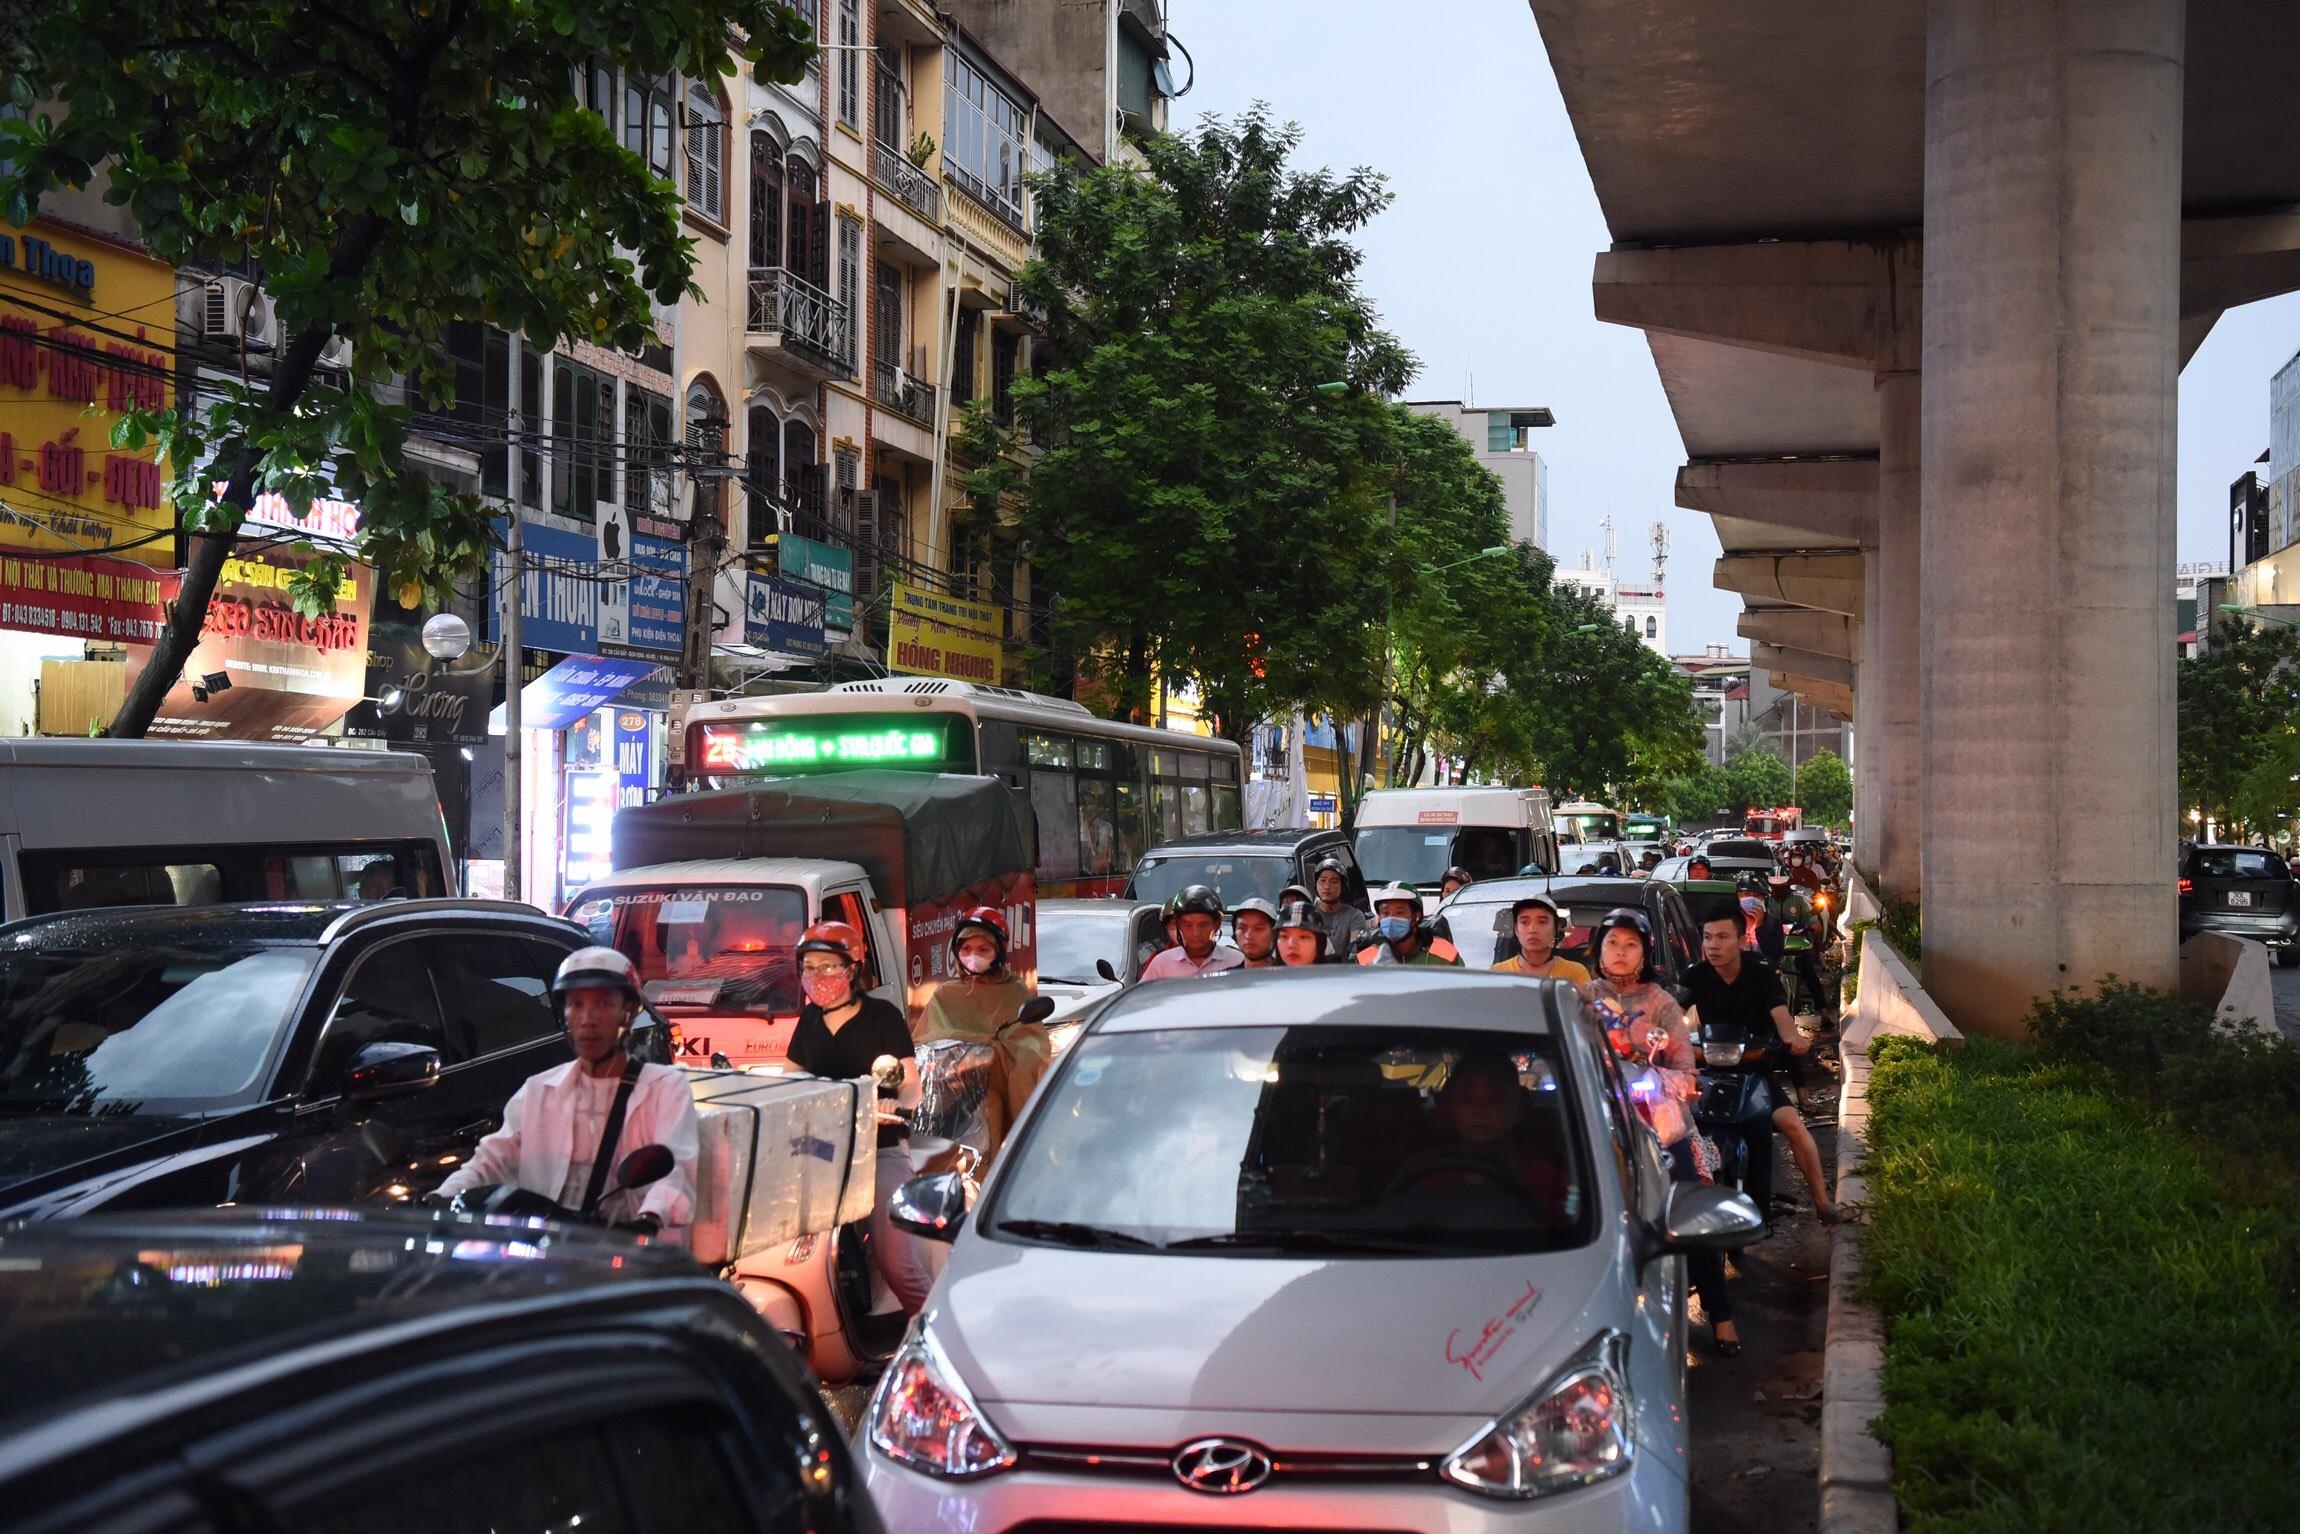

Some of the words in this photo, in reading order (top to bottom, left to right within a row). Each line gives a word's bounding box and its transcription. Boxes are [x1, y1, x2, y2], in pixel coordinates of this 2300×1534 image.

[21, 236, 95, 289] Thoa
[5, 559, 20, 591] NỘI
[24, 560, 45, 590] THẤT
[47, 561, 57, 592] VÀ
[96, 574, 112, 604] MẠI
[116, 572, 143, 602] THÀNH
[145, 579, 161, 609] ĐẠT
[545, 553, 595, 641] THOẠI
[904, 591, 924, 608] TRUNG
[939, 601, 957, 616] TRANG
[367, 650, 394, 673] Shop
[896, 636, 940, 673] HỒNG
[944, 651, 994, 680] NHUNG
[622, 717, 641, 727] 278
[619, 736, 644, 774] MÁY
[614, 893, 677, 905] SUZUKI
[723, 892, 763, 903] ĐẠO
